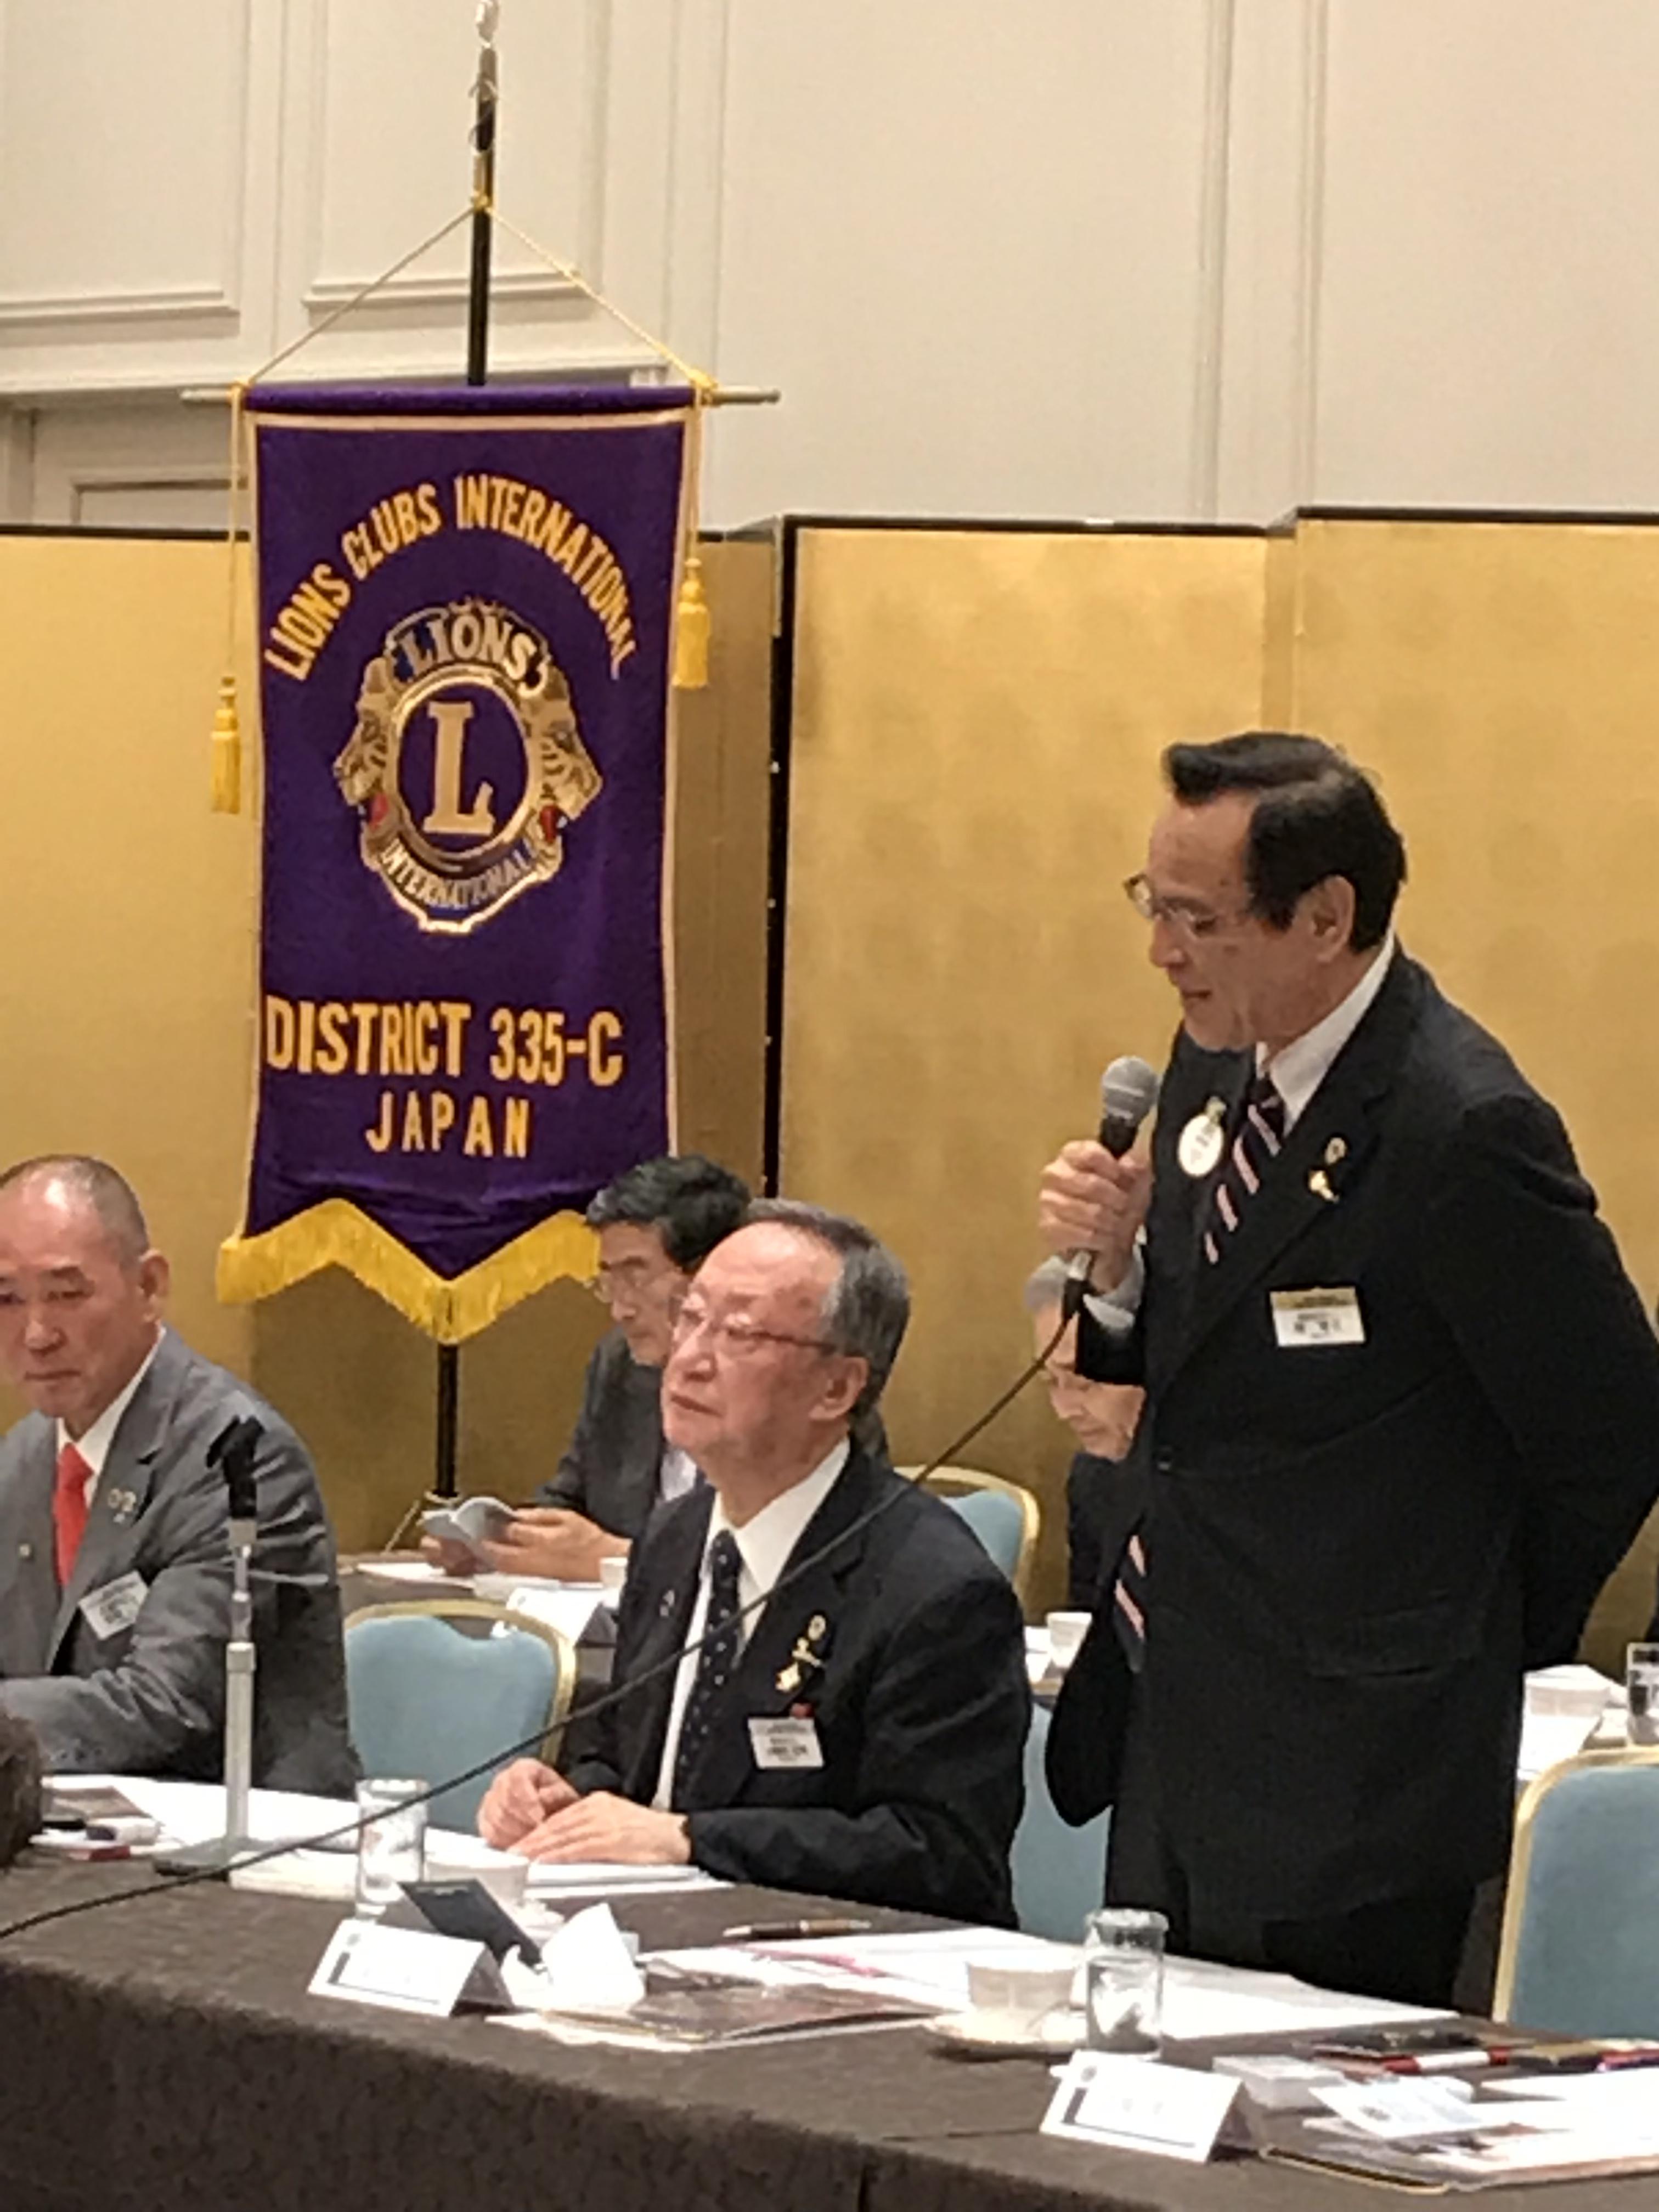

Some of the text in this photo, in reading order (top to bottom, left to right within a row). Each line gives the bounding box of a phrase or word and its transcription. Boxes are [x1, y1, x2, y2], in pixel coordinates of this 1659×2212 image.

[265, 563, 351, 682] LIONS
[341, 483, 441, 580] CLUBS
[399, 614, 537, 682] LIONS
[423, 701, 495, 835] L
[267, 994, 623, 1086] DISTRICT 335-C
[365, 1091, 529, 1158] JAPAN
